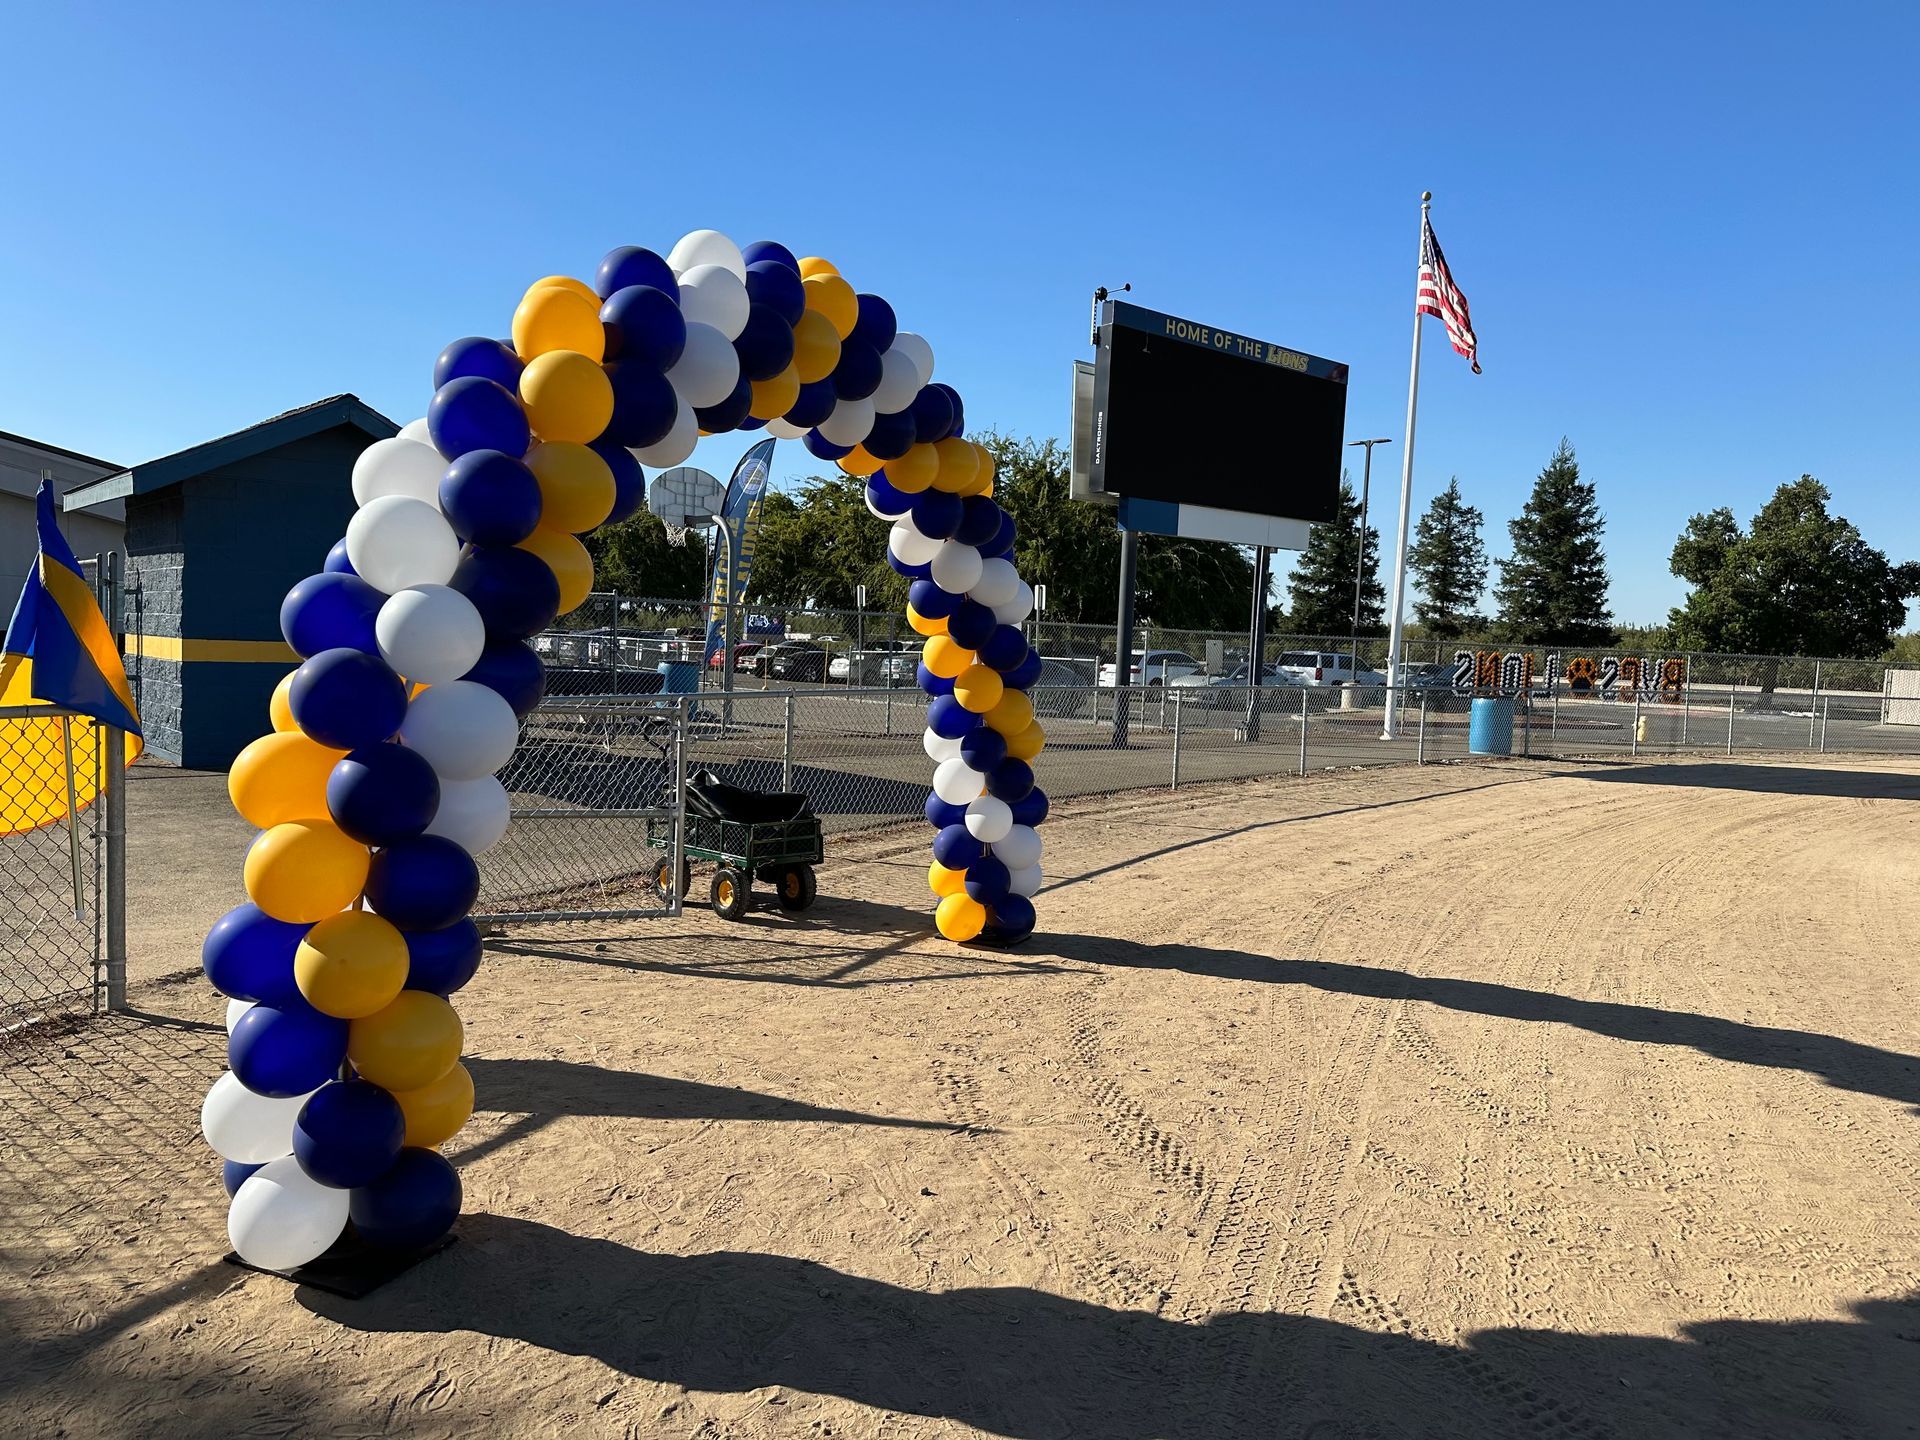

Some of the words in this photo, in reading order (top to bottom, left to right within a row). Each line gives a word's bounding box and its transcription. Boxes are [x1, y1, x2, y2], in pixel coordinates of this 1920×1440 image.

[1166, 319, 1209, 344] HOME
[1214, 333, 1232, 349] OF
[1237, 338, 1262, 358] THE
[1095, 411, 1103, 465] DAKTRONICS
